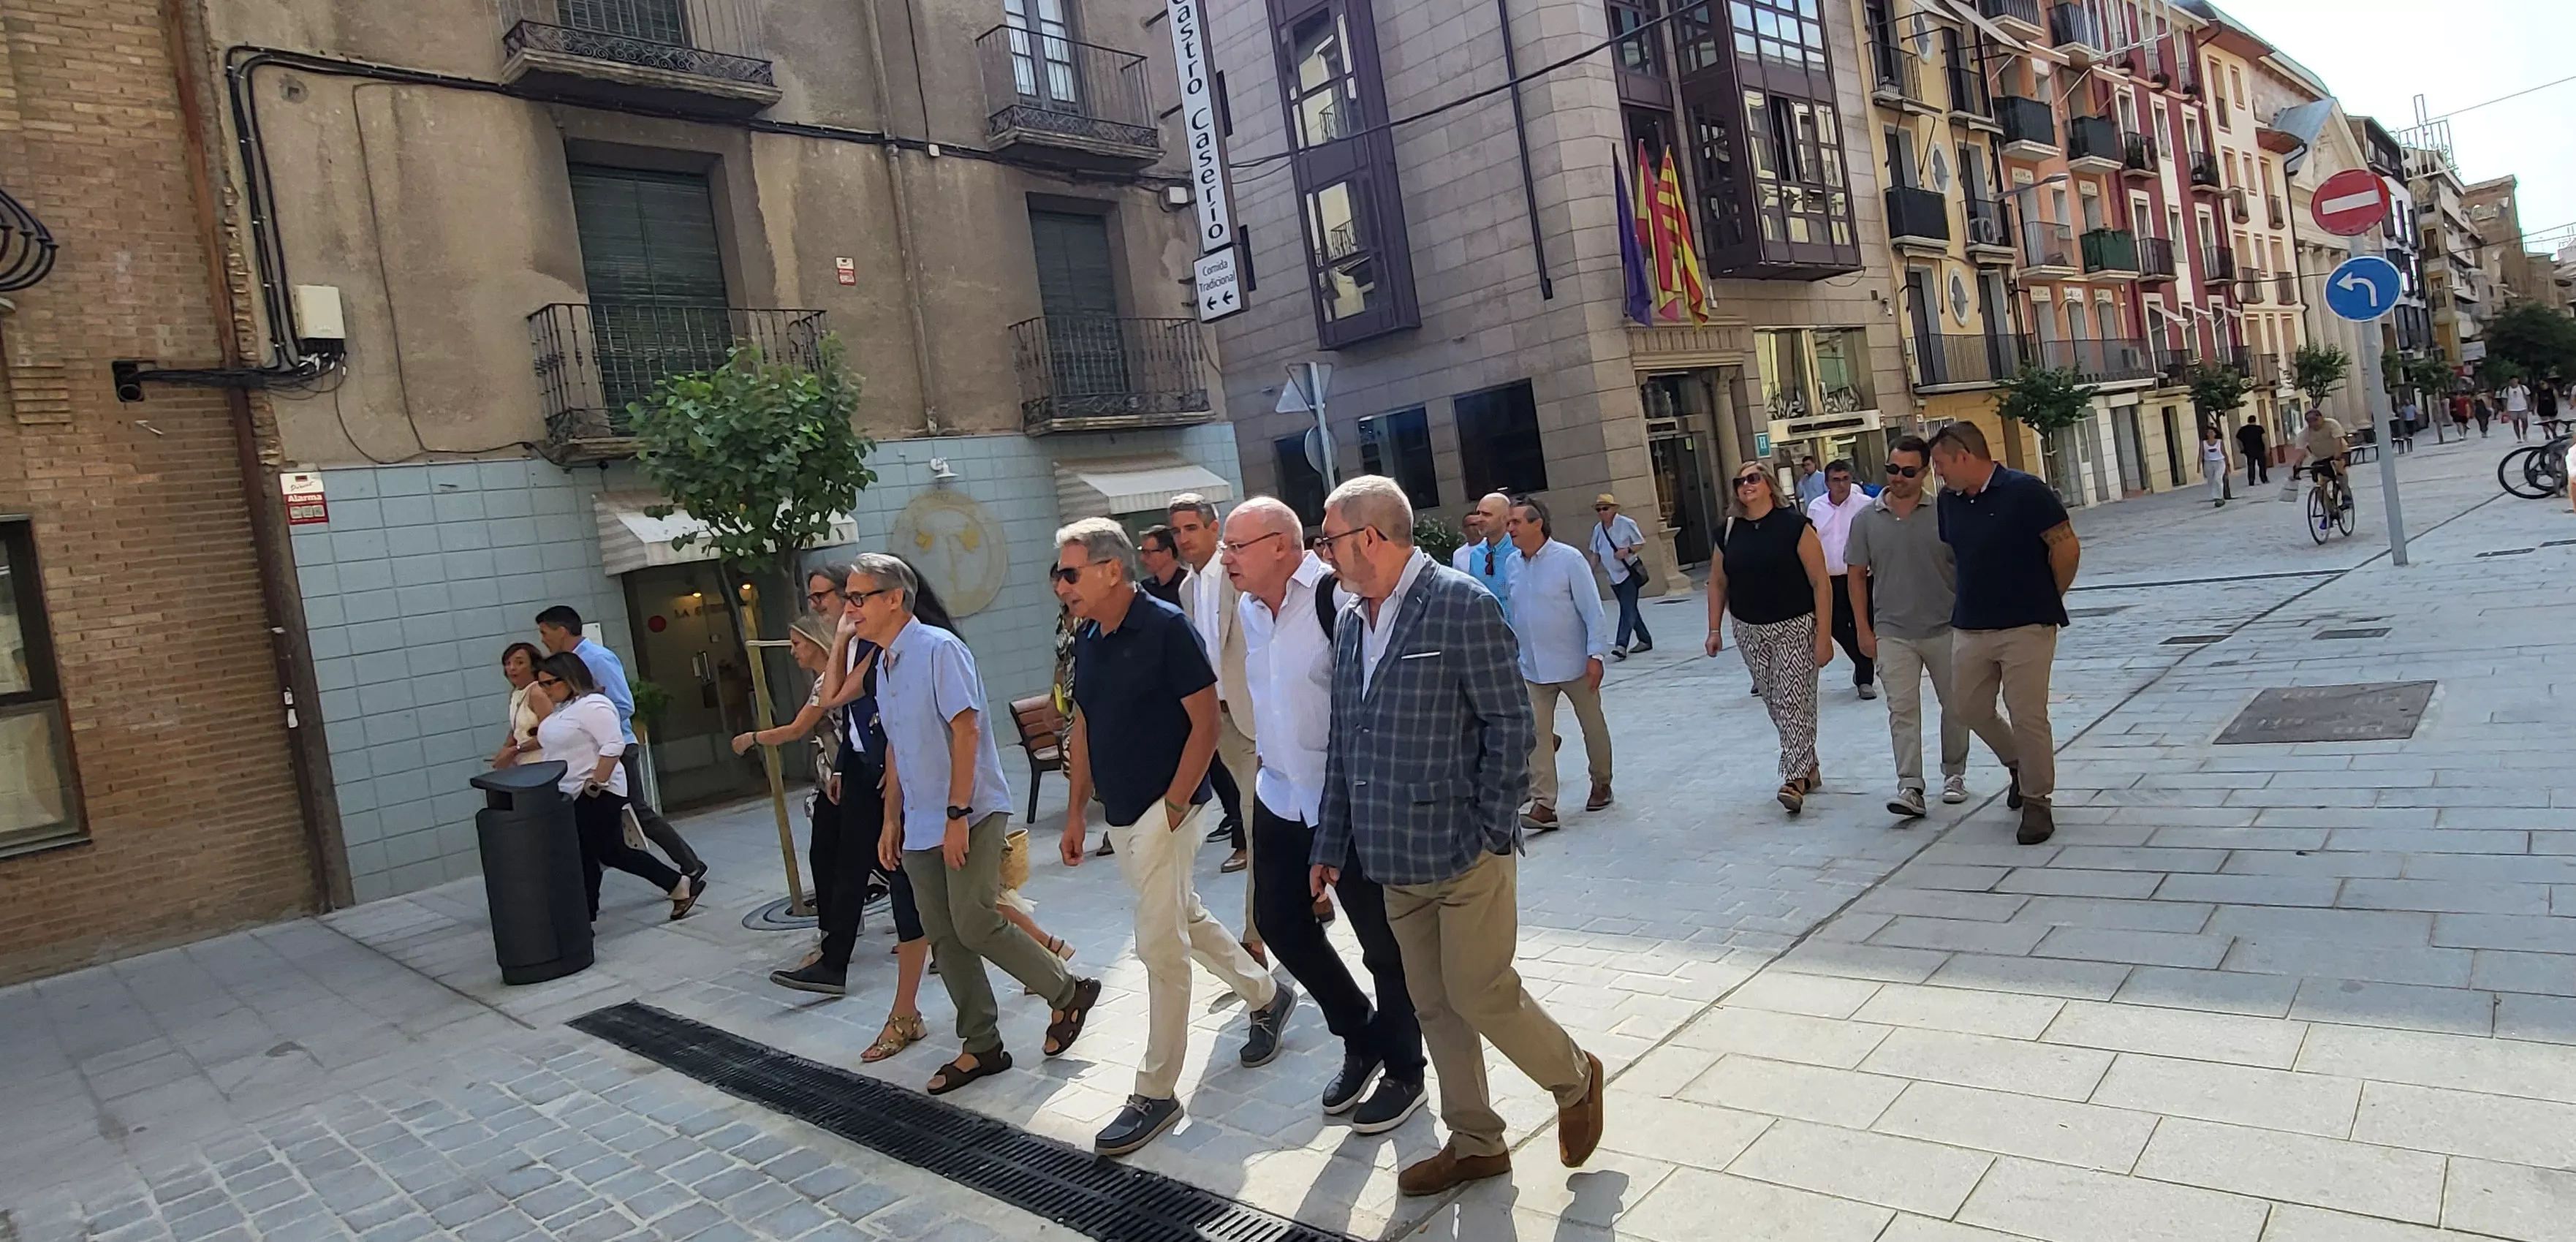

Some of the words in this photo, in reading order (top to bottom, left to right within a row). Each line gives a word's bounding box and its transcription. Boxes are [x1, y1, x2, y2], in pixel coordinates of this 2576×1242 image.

[1171, 0, 1202, 95] astro
[1192, 107, 1224, 238] Caserío
[1202, 260, 1228, 276] Comida
[1199, 270, 1235, 292] Tradicional
